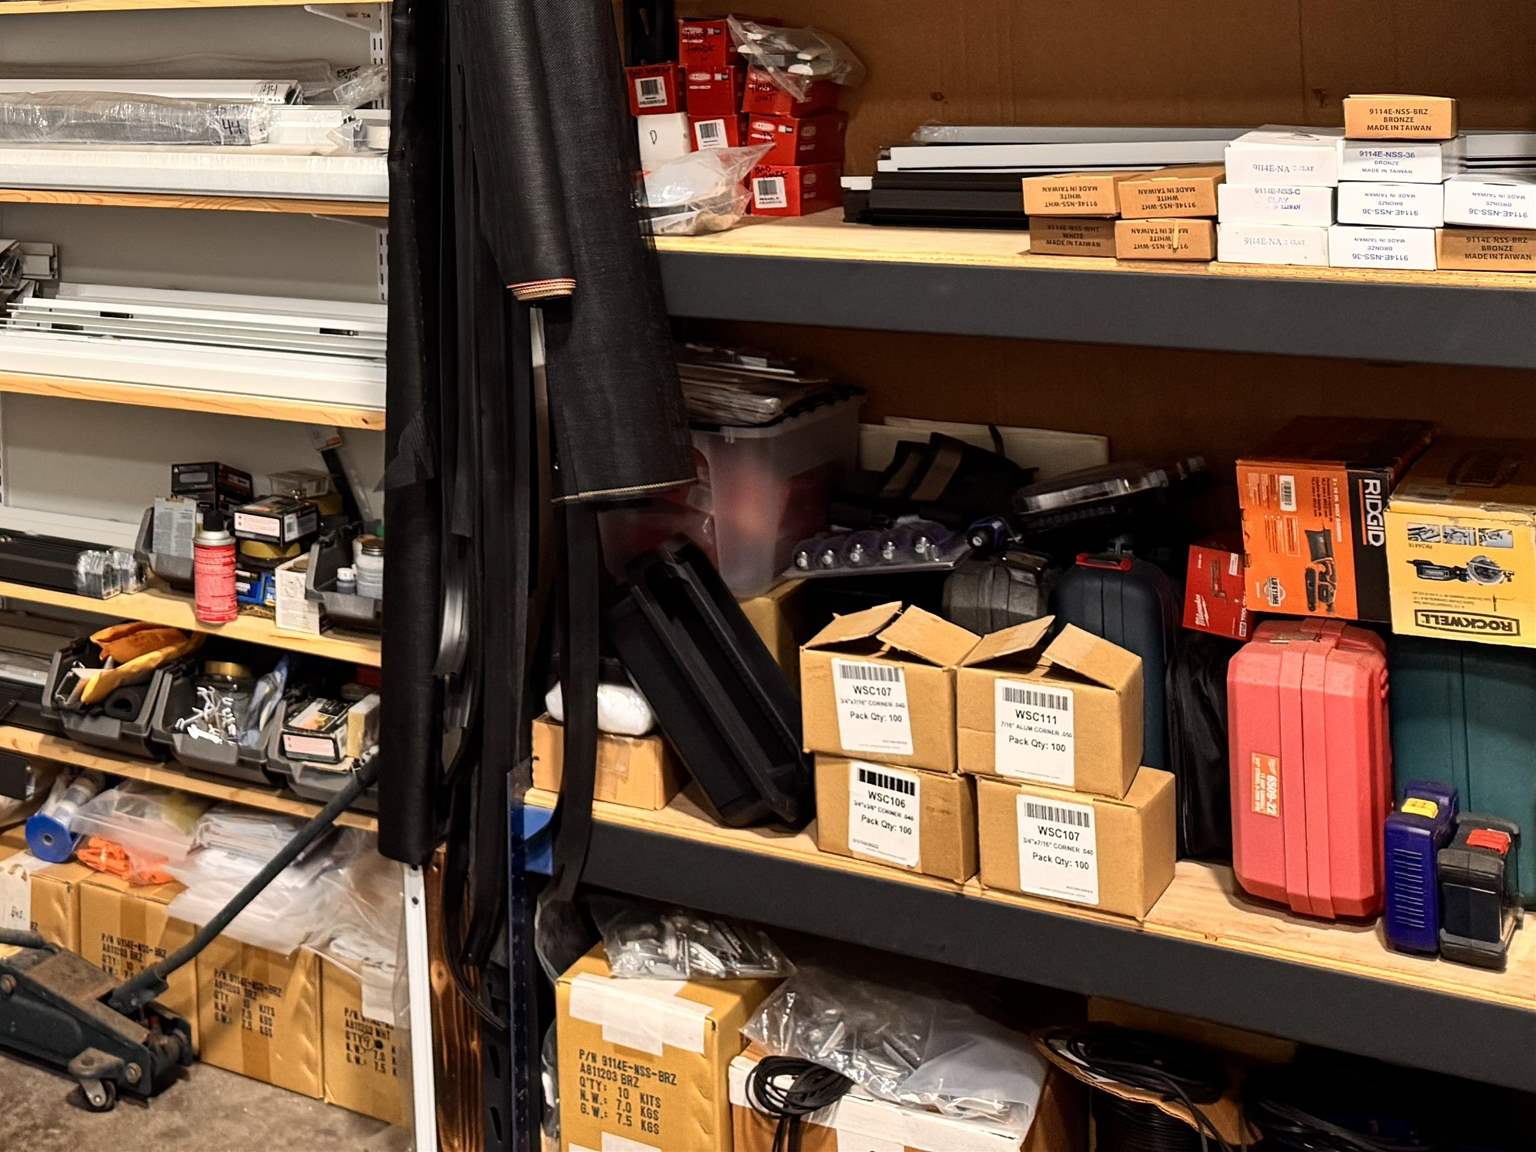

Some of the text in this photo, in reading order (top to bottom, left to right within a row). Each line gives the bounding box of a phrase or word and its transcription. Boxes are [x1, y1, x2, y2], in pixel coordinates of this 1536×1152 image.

[1369, 108, 1429, 116] 9114E-NSS-BRZ
[1383, 116, 1415, 124] BRONZE
[222, 119, 242, 135] 44
[1367, 124, 1386, 132] MADE
[1400, 124, 1432, 132] TAIWAN
[1363, 478, 1385, 547] RIDGID
[1420, 612, 1514, 633] ROCKWELL
[852, 685, 892, 697] WSC107
[850, 710, 902, 722] Pack Qty: 100
[1015, 710, 1058, 725] WSC111
[1008, 735, 1066, 752] Pack Qty: 100
[868, 791, 906, 808] WSC106
[861, 814, 912, 836] Pack Qty: 100
[1037, 825, 1080, 841] WSC107
[1032, 852, 1090, 870] Pack Qty: 100
[579, 1048, 677, 1086] P/N 9114E-NSS-BRZ
[580, 1063, 640, 1088] A811203 BRZ
[617, 1087, 629, 1100] 10
[640, 1093, 661, 1109] KITS
[616, 1099, 632, 1114] 7.0
[640, 1106, 659, 1120] KGS
[617, 1112, 633, 1128] 7.5
[640, 1120, 660, 1135] KGS
